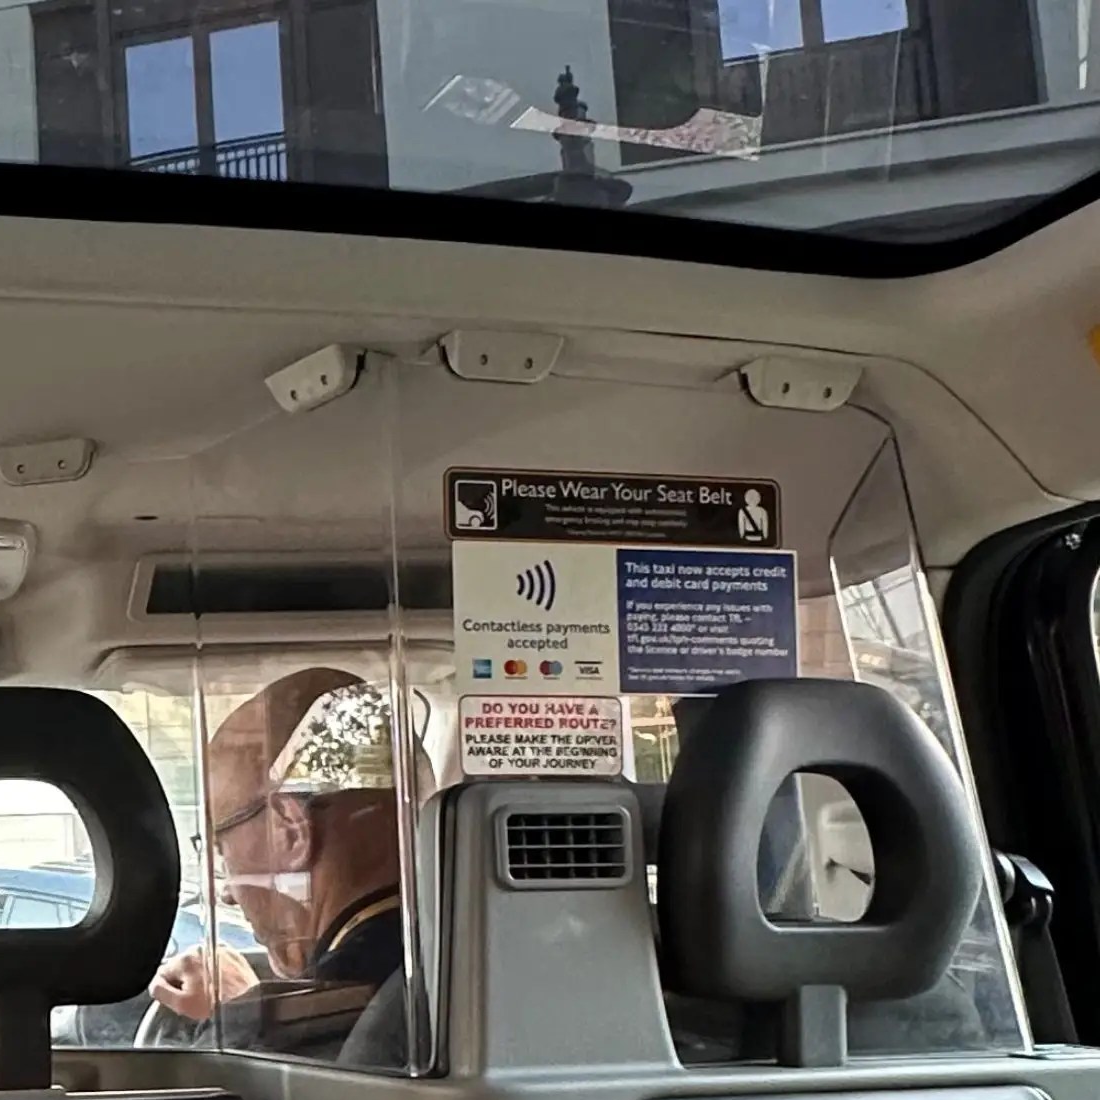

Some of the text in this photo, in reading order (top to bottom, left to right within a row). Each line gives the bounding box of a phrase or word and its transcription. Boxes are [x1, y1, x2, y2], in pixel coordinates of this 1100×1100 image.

[501, 478, 733, 506] Please Wear Your Seat Belt
[625, 562, 787, 578] This taxi now accepts credit
[625, 577, 769, 593] and debit card payments
[462, 619, 611, 636] Contactless payments
[507, 637, 568, 651] accepted
[579, 666, 600, 675] VISA
[482, 703, 600, 716] DO YOU HAVE A
[464, 717, 617, 730] PREFERRED ROUTE?
[465, 734, 511, 745] PLEASE
[514, 734, 548, 745] MAKE
[550, 735, 573, 745] THE
[467, 746, 618, 758] AWARE AT THE BEGINNING
[488, 758, 598, 770] OF YOUR JOURNEY
